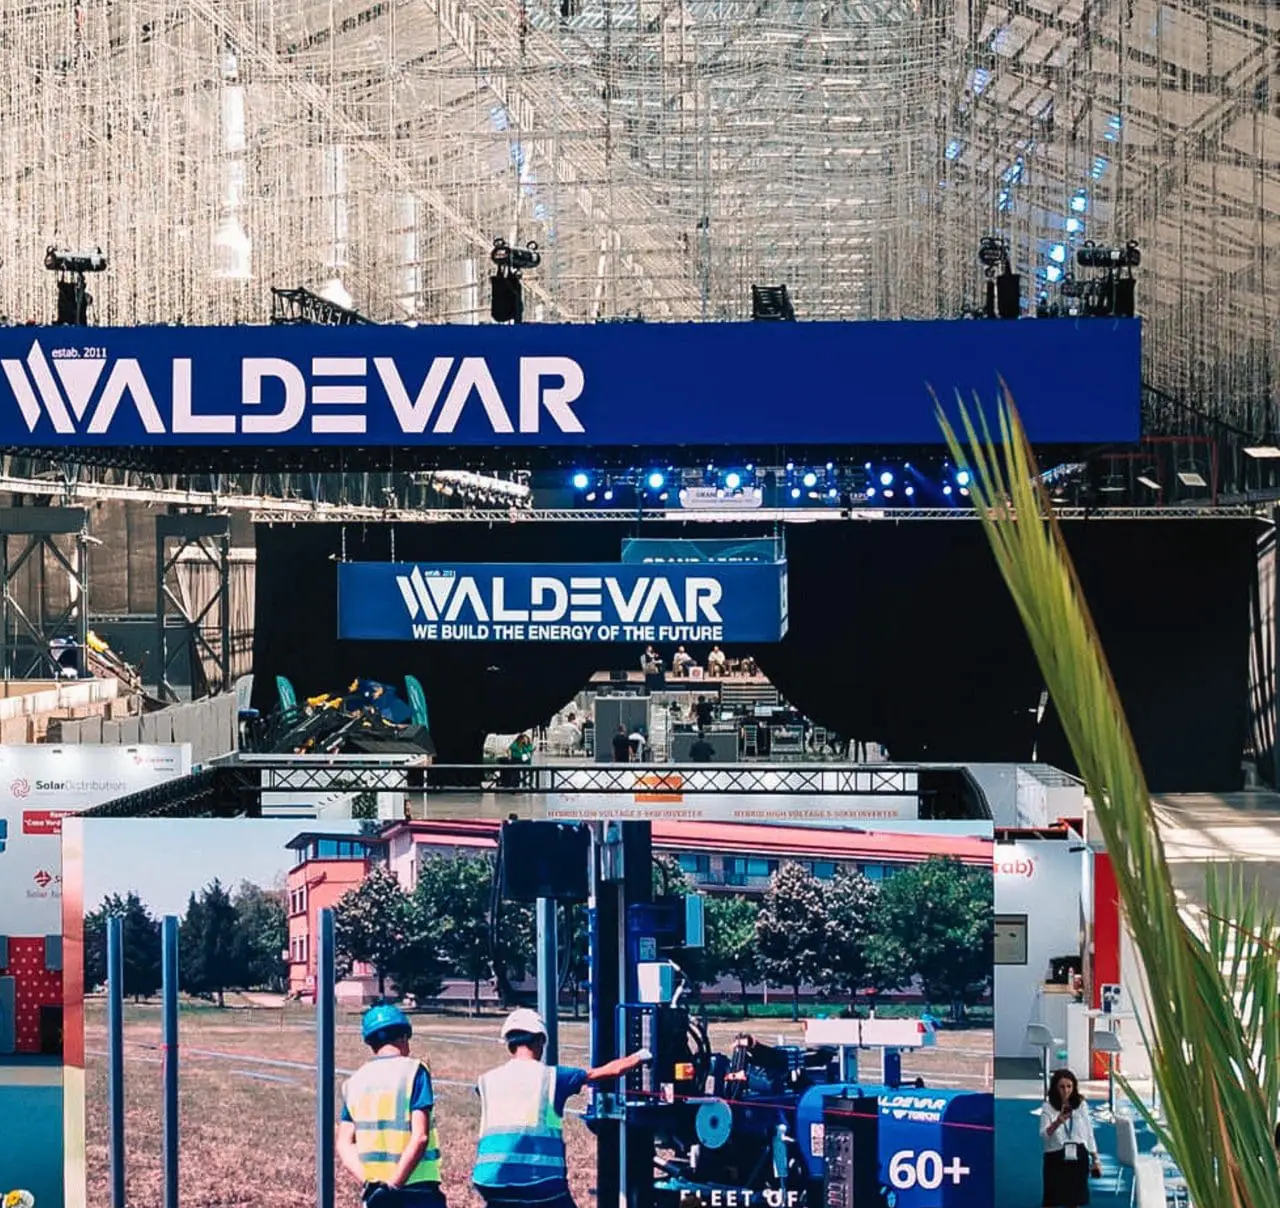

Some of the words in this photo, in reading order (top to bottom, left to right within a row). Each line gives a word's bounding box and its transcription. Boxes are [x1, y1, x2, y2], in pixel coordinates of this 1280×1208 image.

[51, 347, 81, 357] estab.
[83, 347, 107, 357] 2011
[0, 338, 586, 433] WALDEVAR
[396, 564, 723, 622] WALDEVAR
[412, 624, 437, 640] WE
[441, 624, 489, 640] BUILD
[493, 624, 524, 640] THE
[528, 624, 593, 640] ENERGY
[598, 624, 619, 640] OF
[623, 624, 654, 640] THE
[659, 624, 723, 640] FUTURE
[878, 1096, 947, 1110] ALDEVAR
[889, 1150, 970, 1189] 60+
[767, 1190, 798, 1207] OF
